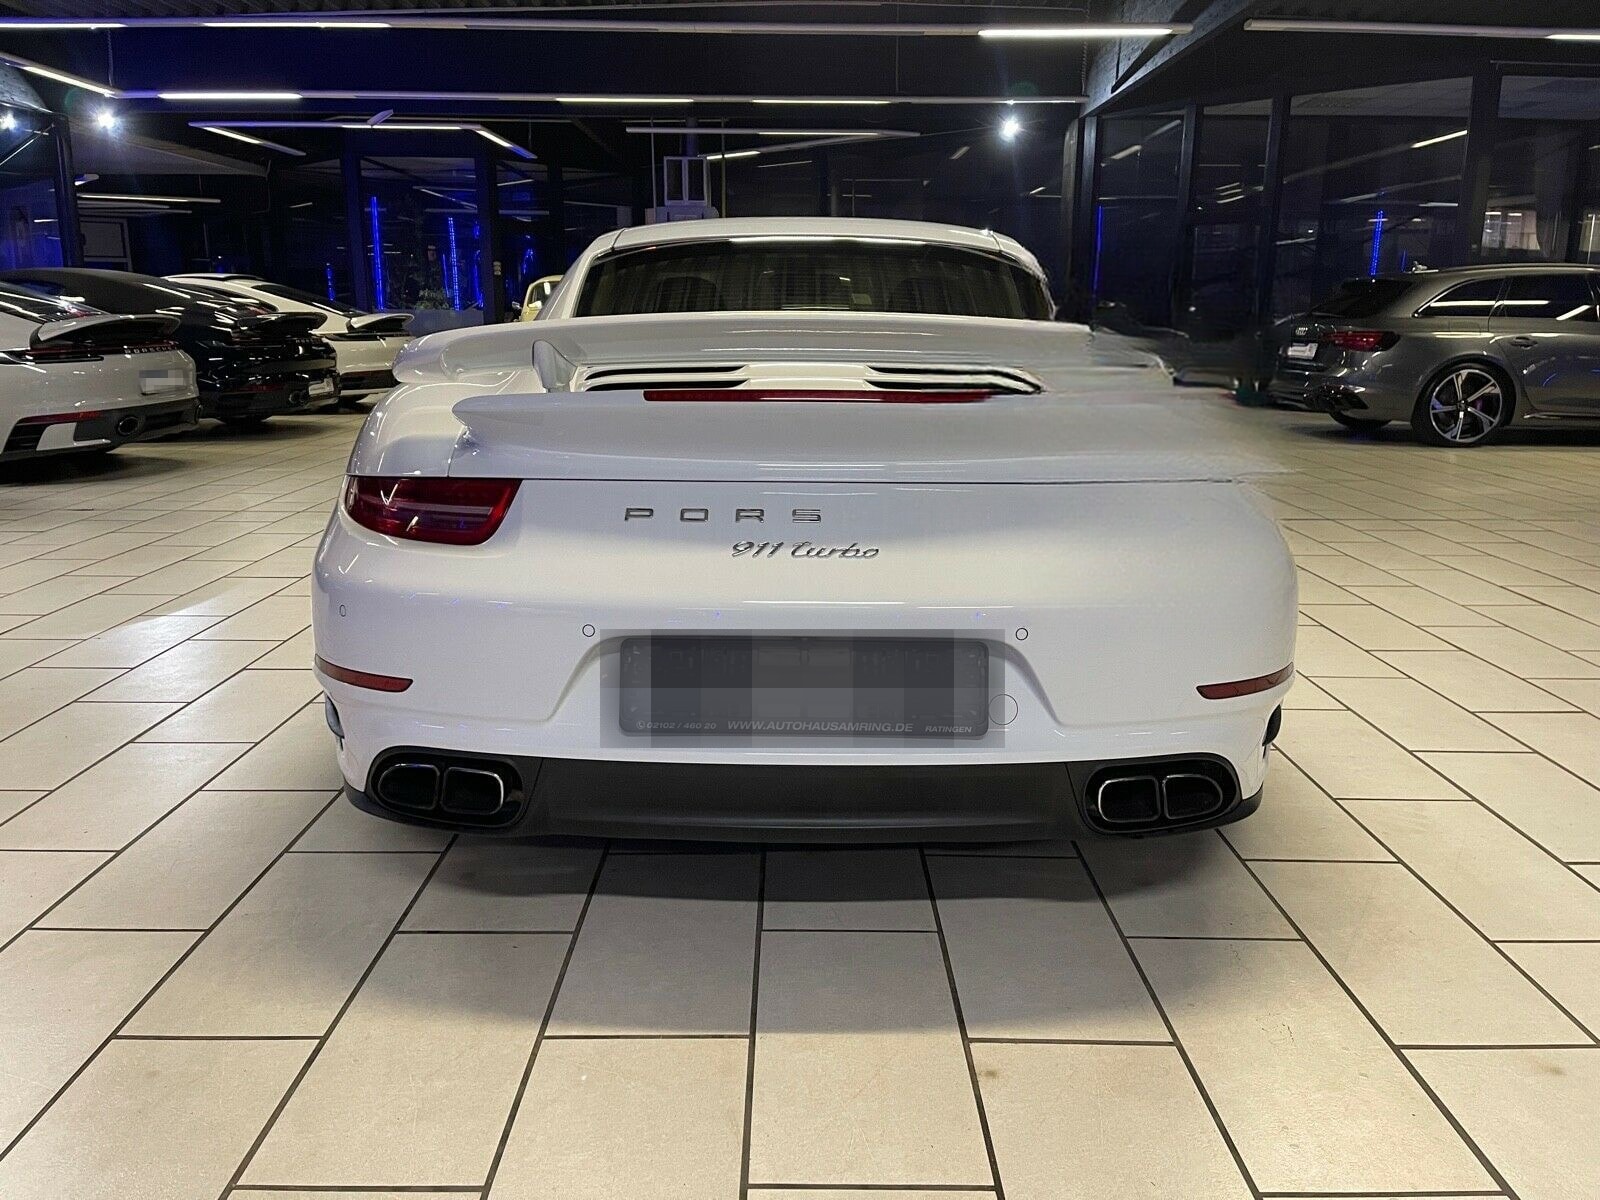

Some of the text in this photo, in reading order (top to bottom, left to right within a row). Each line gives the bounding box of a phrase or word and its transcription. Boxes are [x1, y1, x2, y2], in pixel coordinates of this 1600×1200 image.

[624, 507, 821, 523] PORS
[731, 541, 880, 559] 911 turbo
[704, 722, 717, 730] 20
[727, 720, 914, 732] WWW.AUTOHAUSAMRING.DE
[925, 725, 973, 733] RATINGEN
